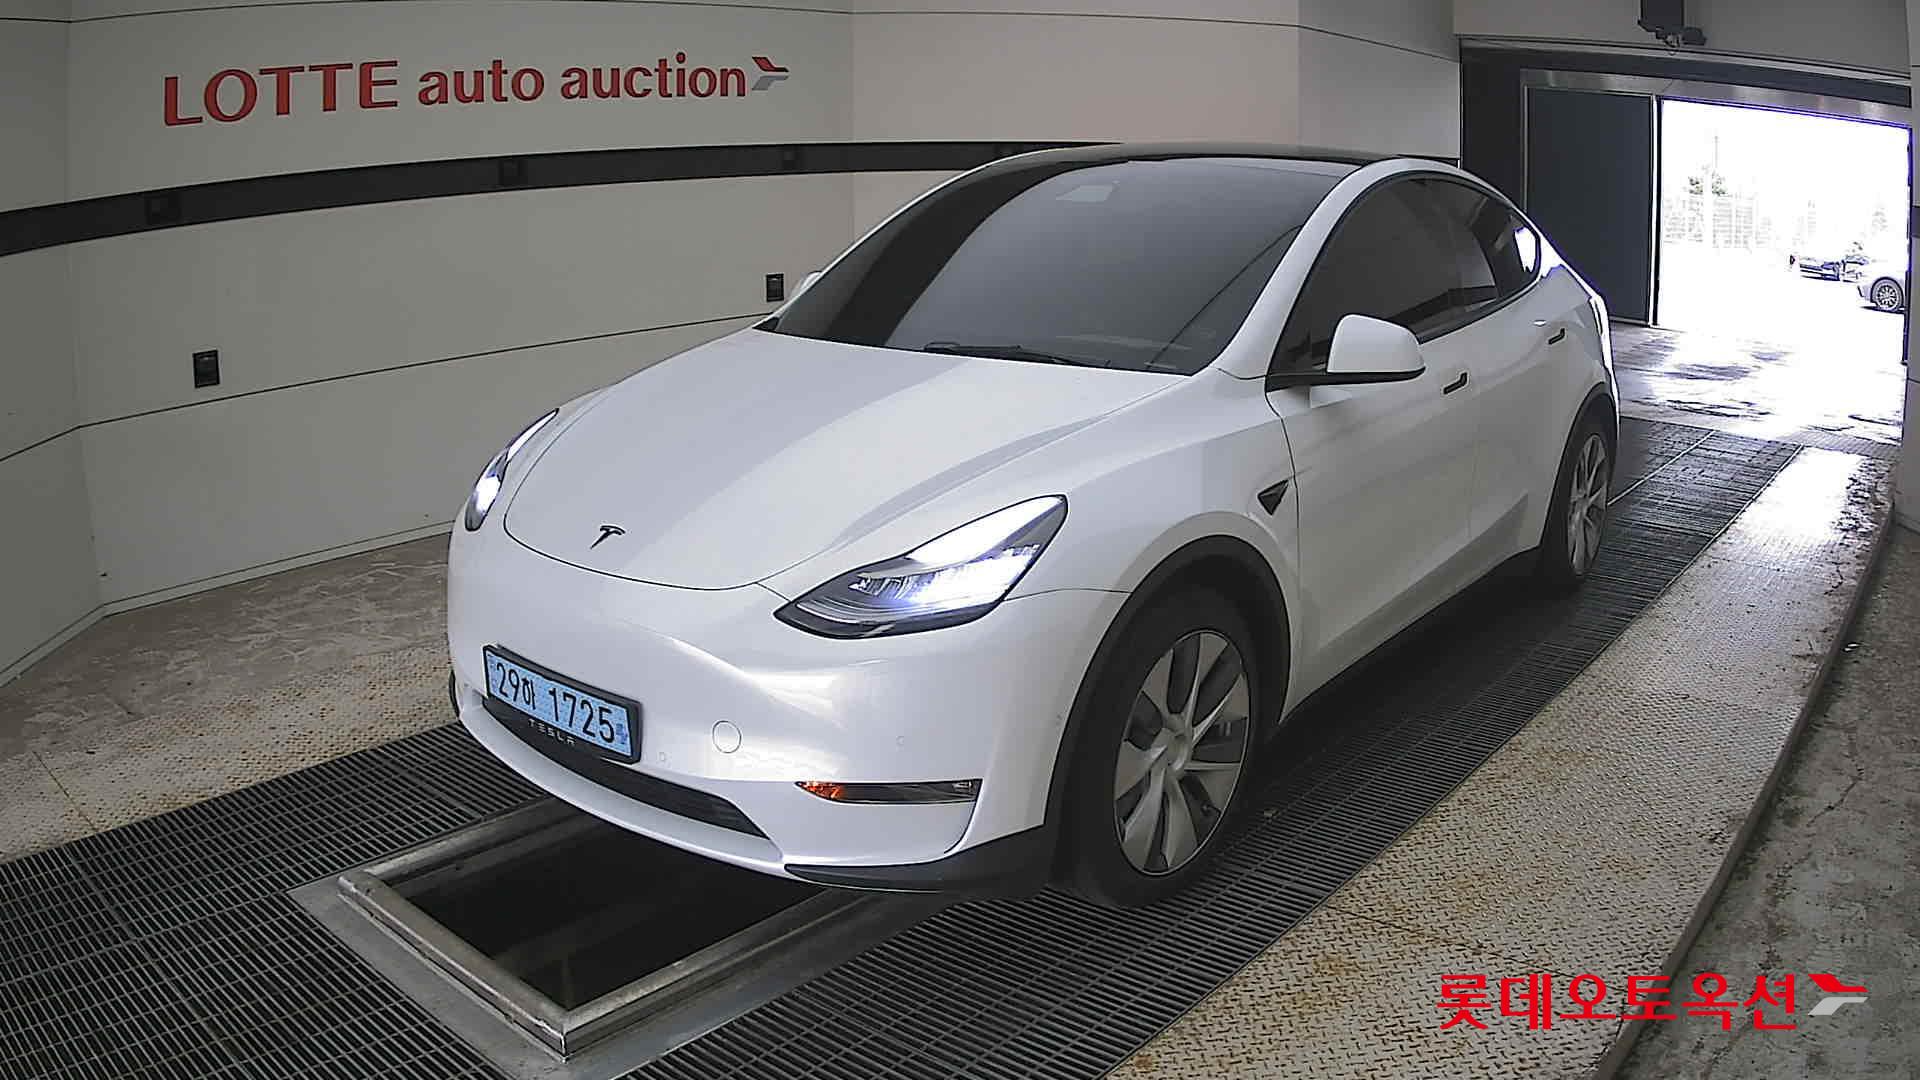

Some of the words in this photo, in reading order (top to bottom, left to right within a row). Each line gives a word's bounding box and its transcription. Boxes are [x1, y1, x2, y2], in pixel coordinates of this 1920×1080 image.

[164, 60, 398, 126] LOTTE
[418, 60, 544, 106] auto
[560, 52, 746, 98] auction
[496, 662, 537, 711] 29하
[548, 687, 616, 744] 1725
[528, 718, 577, 746] TESLA
